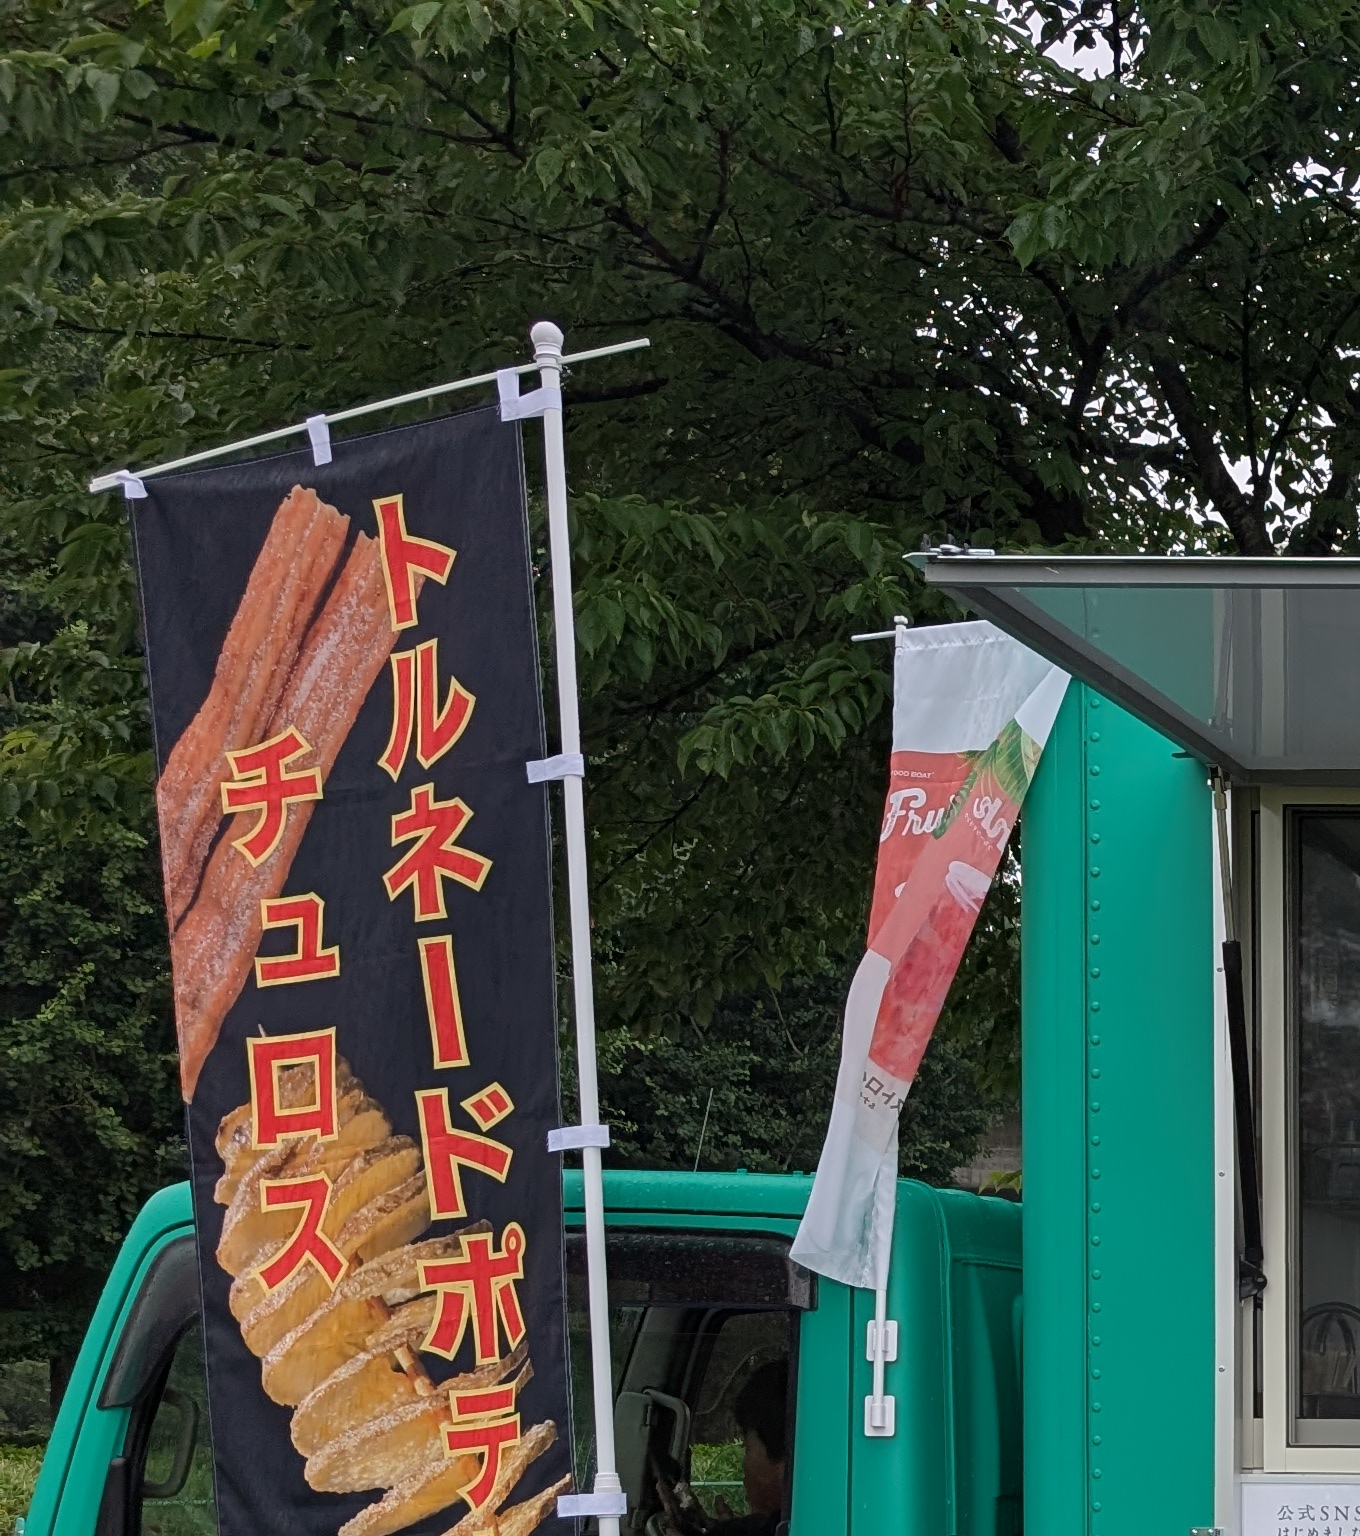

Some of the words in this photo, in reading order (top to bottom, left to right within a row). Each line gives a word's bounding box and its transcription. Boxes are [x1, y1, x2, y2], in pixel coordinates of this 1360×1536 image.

[880, 787, 955, 843] Fru
[221, 725, 348, 1296] チュロス
